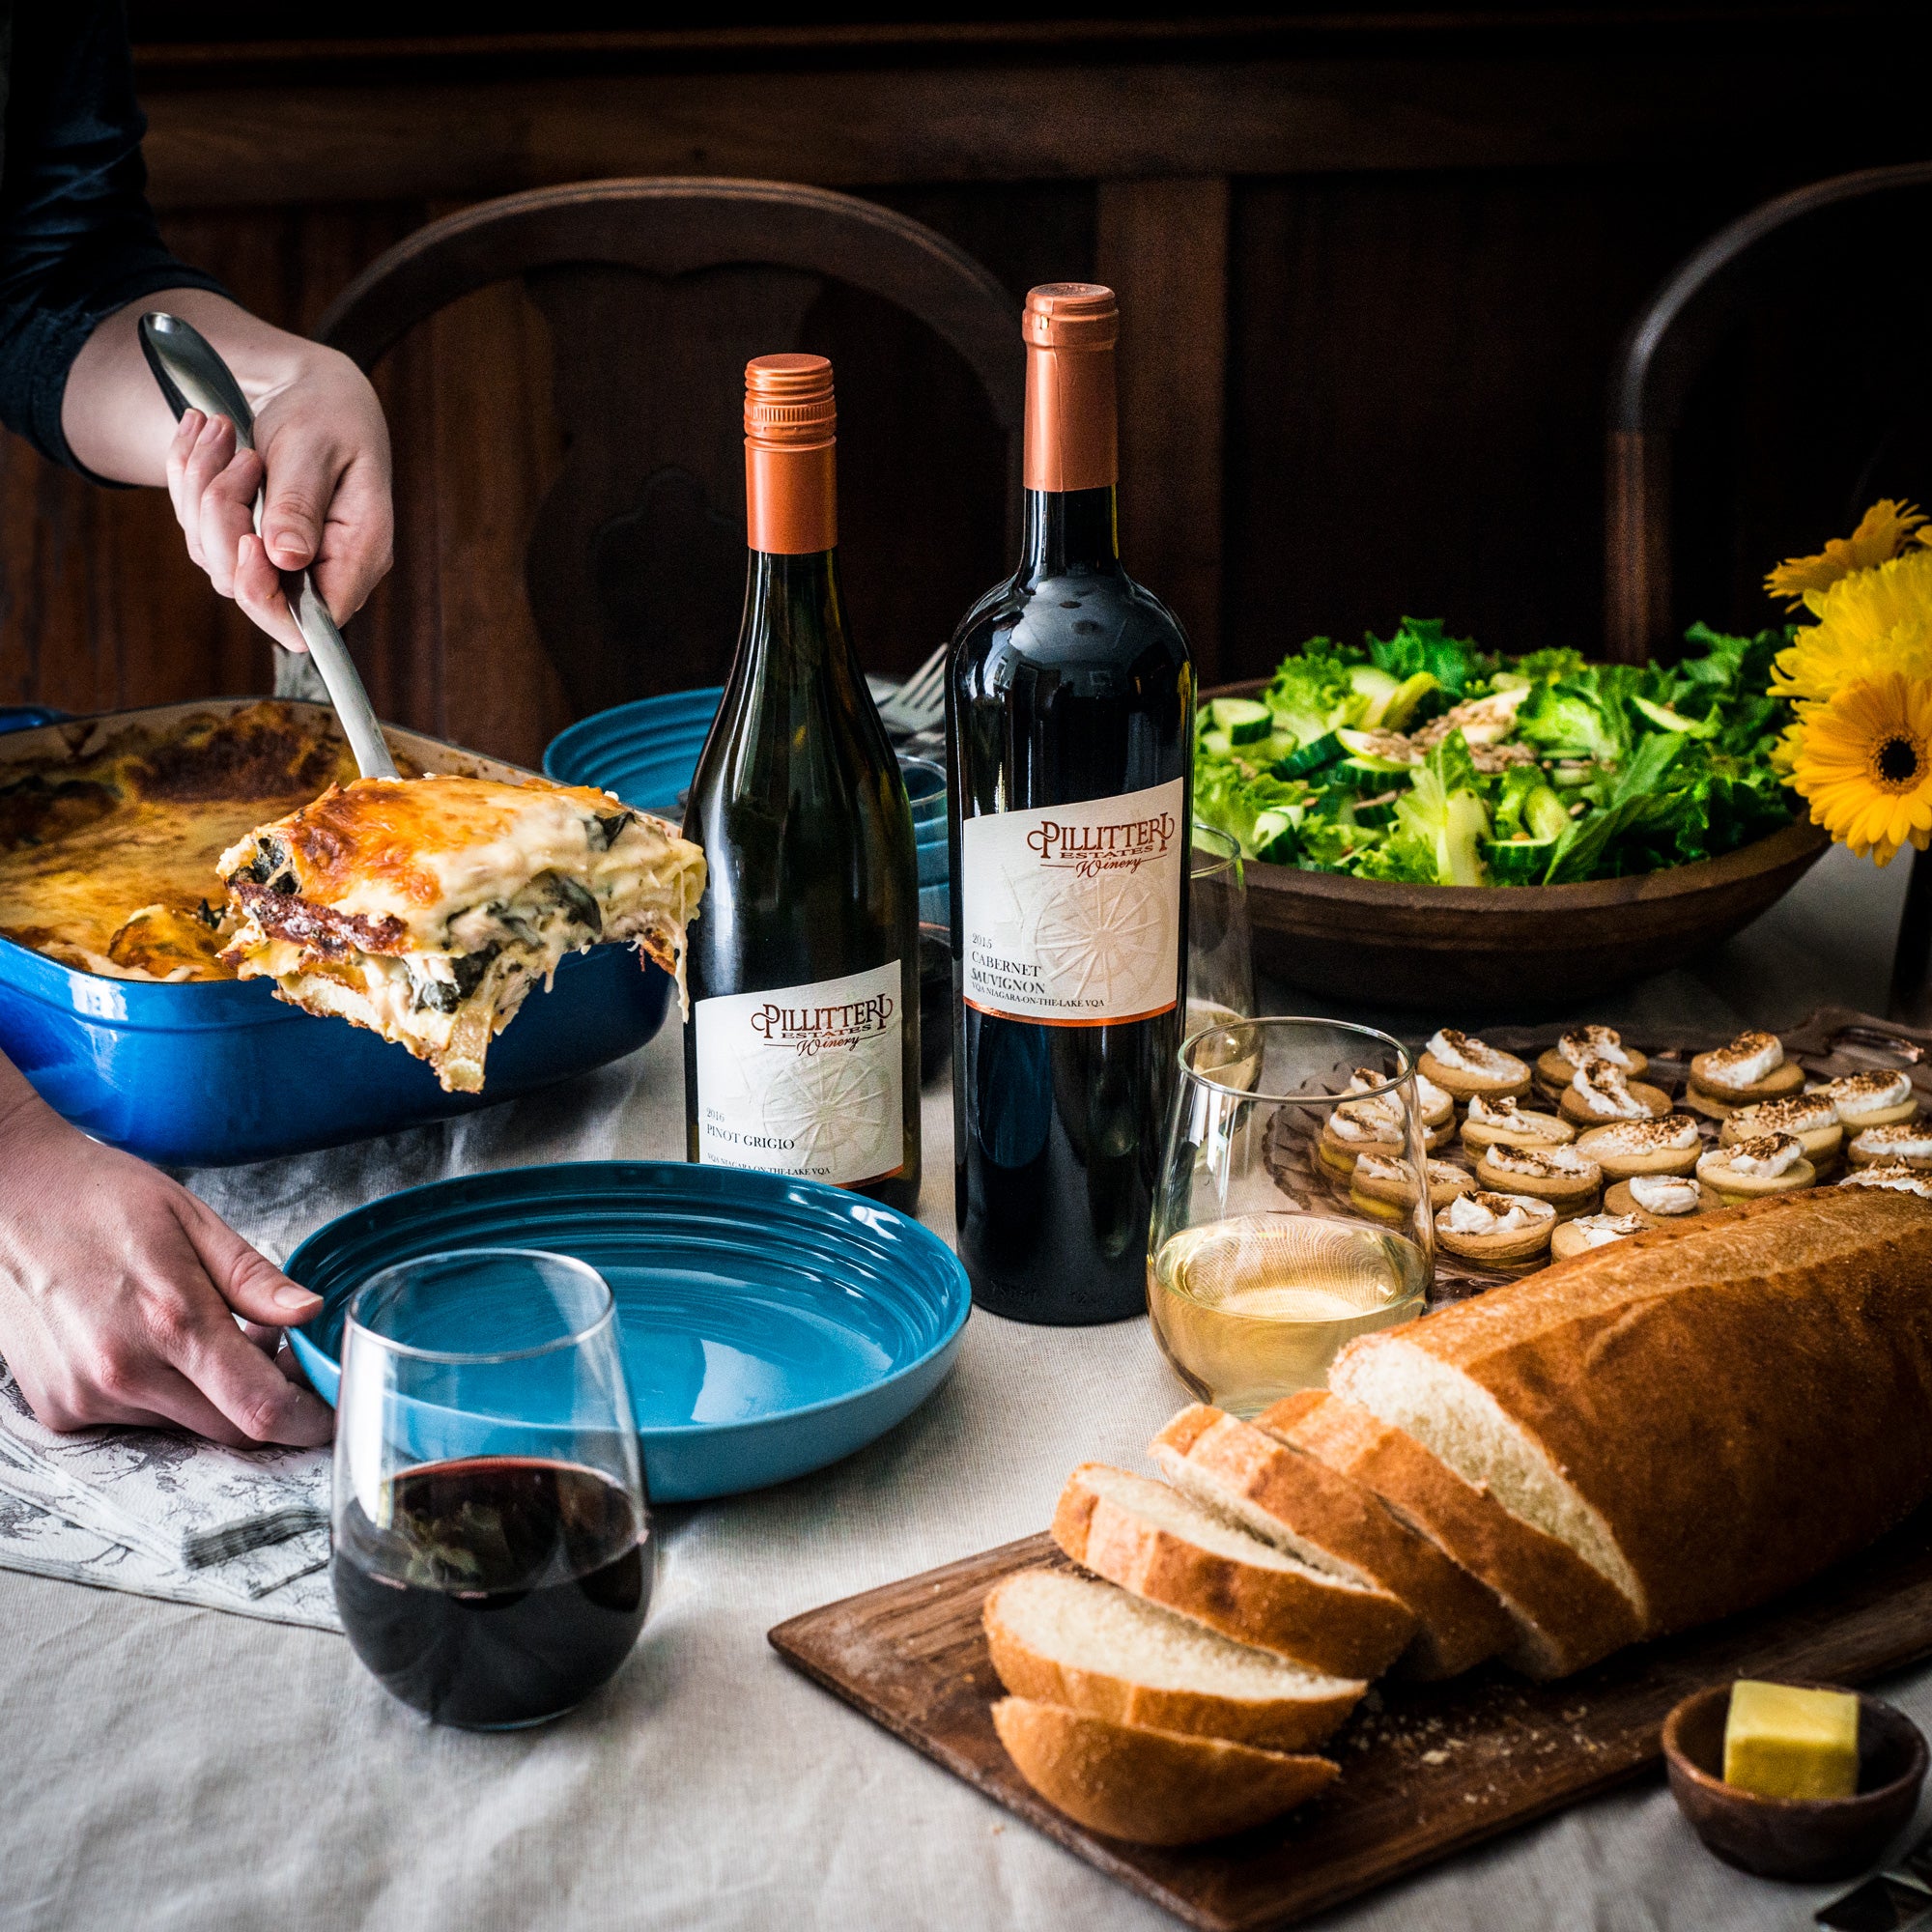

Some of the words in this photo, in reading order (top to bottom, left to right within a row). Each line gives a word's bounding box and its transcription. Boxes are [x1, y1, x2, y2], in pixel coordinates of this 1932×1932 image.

[1027, 811, 1175, 859] PILLITTERI
[1060, 845, 1153, 859] ESTATES
[1075, 857, 1142, 878] Winery
[972, 933, 992, 949] 2015
[972, 951, 1041, 978] CABERNET
[971, 968, 1045, 994] SAUVIGNON
[971, 981, 985, 993] VQA
[986, 987, 1083, 1008] NIAGARA-ON-THE-LAKE
[752, 993, 893, 1038] PILLITTERI
[781, 1024, 871, 1038] ESTATES
[797, 1037, 860, 1056] Winery
[707, 1107, 724, 1122] 2016
[707, 1123, 740, 1144] PINOT
[743, 1135, 795, 1150] GRIGIO
[811, 1167, 831, 1176] VQA
